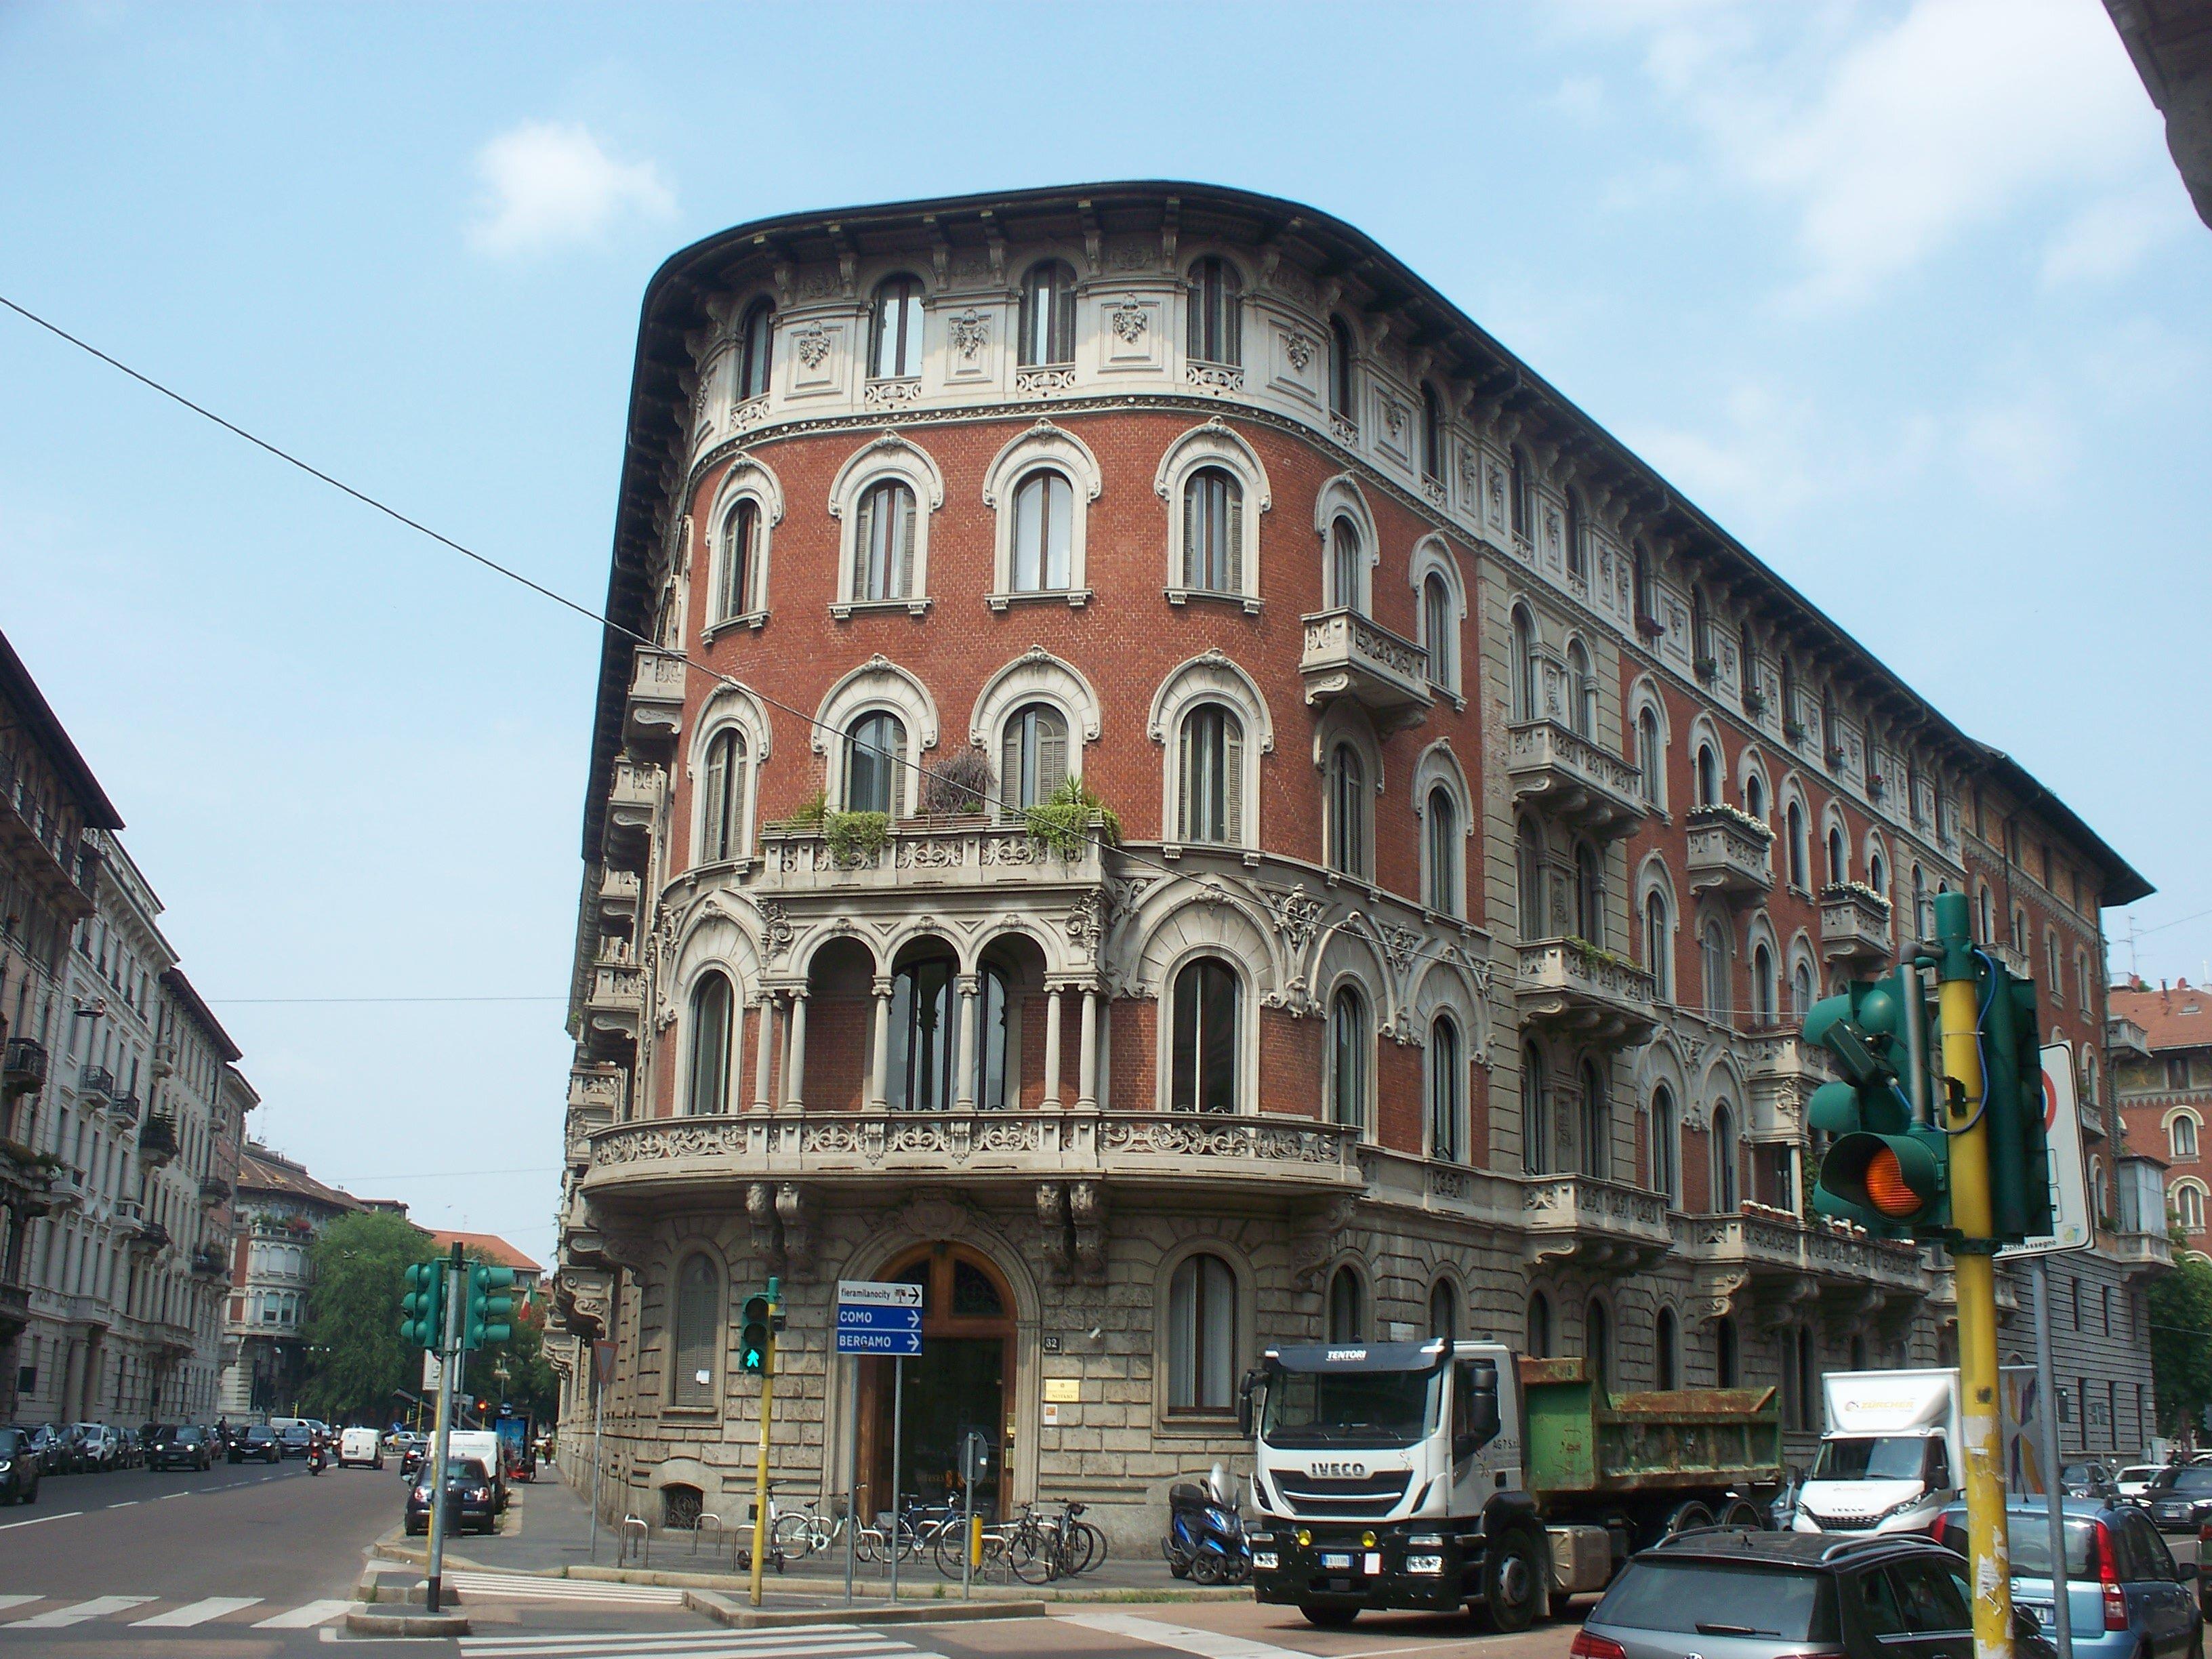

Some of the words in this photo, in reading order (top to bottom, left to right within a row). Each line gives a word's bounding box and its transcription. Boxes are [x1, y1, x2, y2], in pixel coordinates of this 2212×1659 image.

[841, 1288, 890, 1300] fieramilanocity
[840, 1311, 872, 1323] COMO
[839, 1335, 891, 1347] BERGAMO
[1046, 1338, 1057, 1348] 32
[1328, 1350, 1366, 1359] TENTORI
[1311, 1462, 1365, 1477] IVECO
